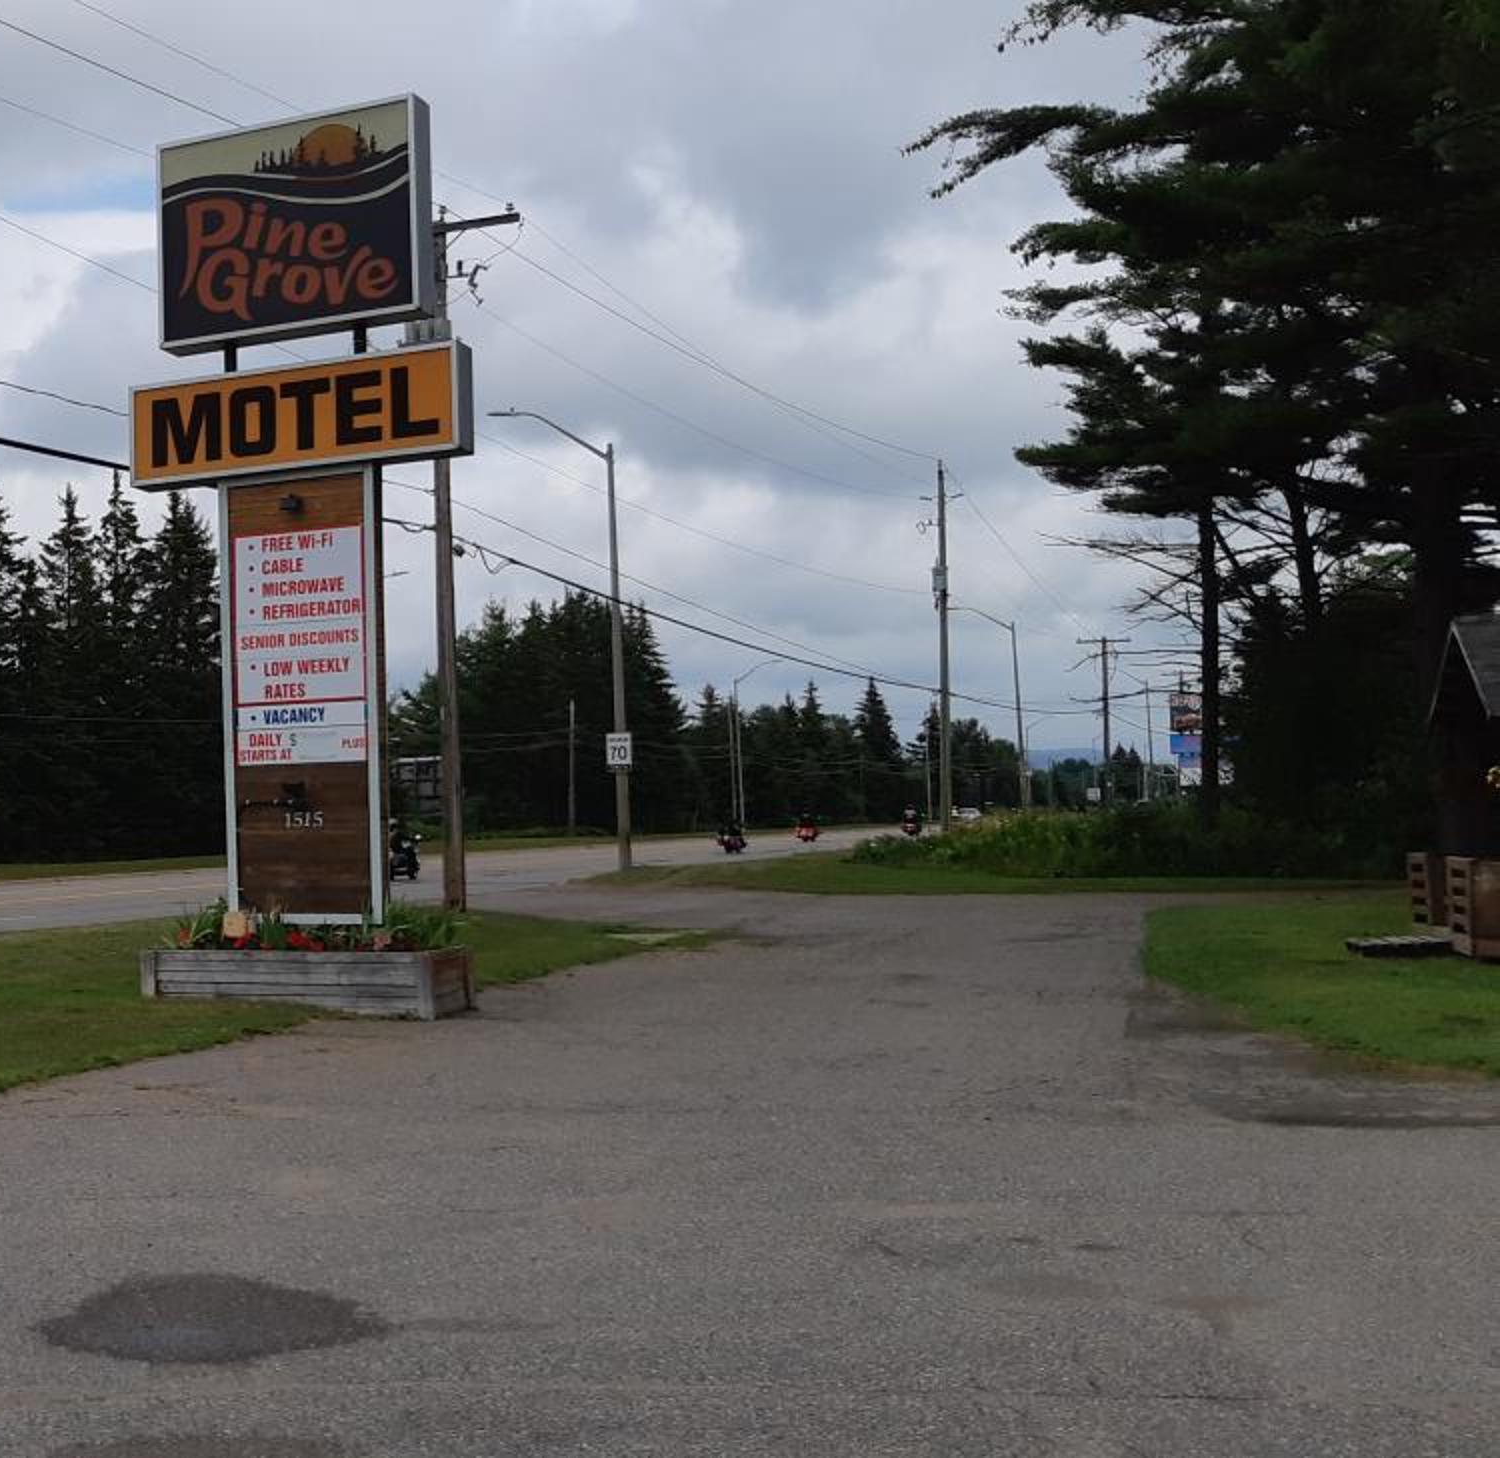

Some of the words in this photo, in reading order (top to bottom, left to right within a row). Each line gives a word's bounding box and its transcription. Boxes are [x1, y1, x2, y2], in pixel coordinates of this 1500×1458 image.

[179, 197, 347, 301] Pine
[196, 245, 399, 321] Grove
[151, 366, 440, 469] MOTEL
[261, 535, 293, 553] FREE
[297, 532, 333, 549] Wi-Fi
[261, 558, 304, 575] CABLE
[262, 576, 345, 598] MICROWAVE
[262, 599, 361, 620] REFRIGERATOR
[241, 634, 285, 650] SENIOR
[289, 629, 359, 647] DISCOUNTS
[263, 661, 292, 677] LOW
[297, 657, 350, 674] WEEKLY
[264, 684, 306, 699] RATES
[263, 707, 325, 725] VACANCY
[249, 733, 282, 748] DAILY
[239, 750, 277, 762] STARTS
[279, 749, 292, 760] AT
[611, 745, 627, 760] 70
[284, 811, 324, 828] 1515
